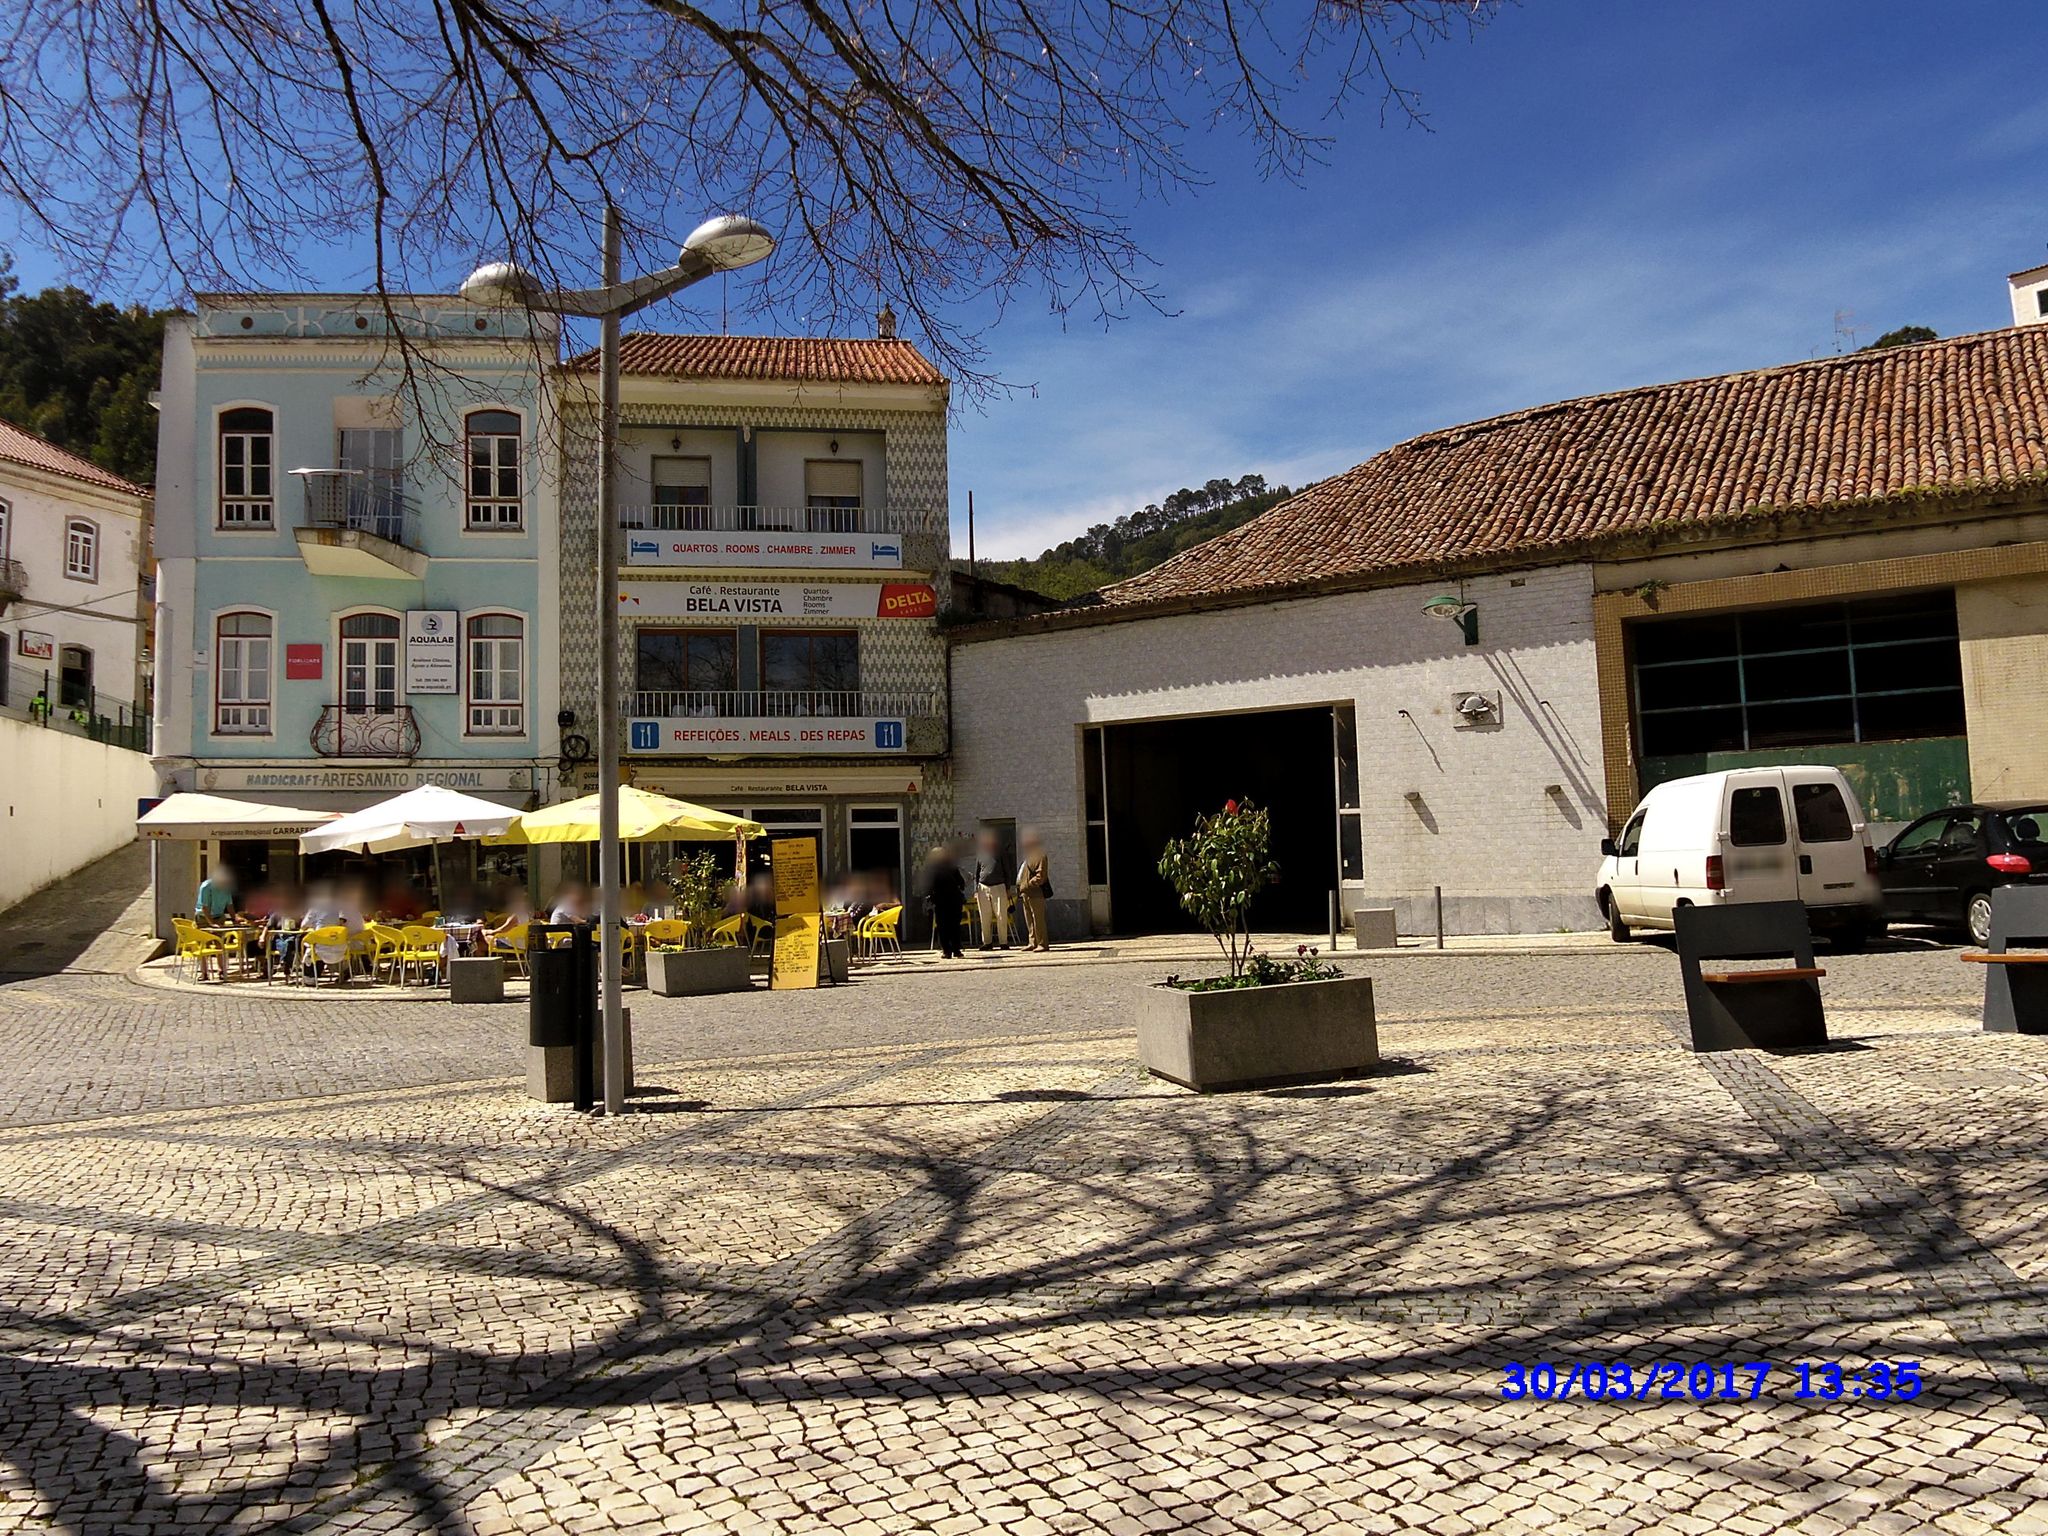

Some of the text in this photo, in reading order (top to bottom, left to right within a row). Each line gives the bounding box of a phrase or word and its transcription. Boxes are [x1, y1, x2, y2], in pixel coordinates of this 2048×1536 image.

[672, 544, 856, 555] QUARTOS ROOMS CHAMBRE ZIMMER
[689, 585, 780, 596] Café Restaurante
[803, 588, 830, 596] Quartos
[686, 598, 783, 613] BELA VISTA
[885, 591, 933, 611] DELTA
[674, 728, 865, 743] REFEIÇÕES MEALS DES REPAS
[416, 772, 484, 787] REGIONAL
